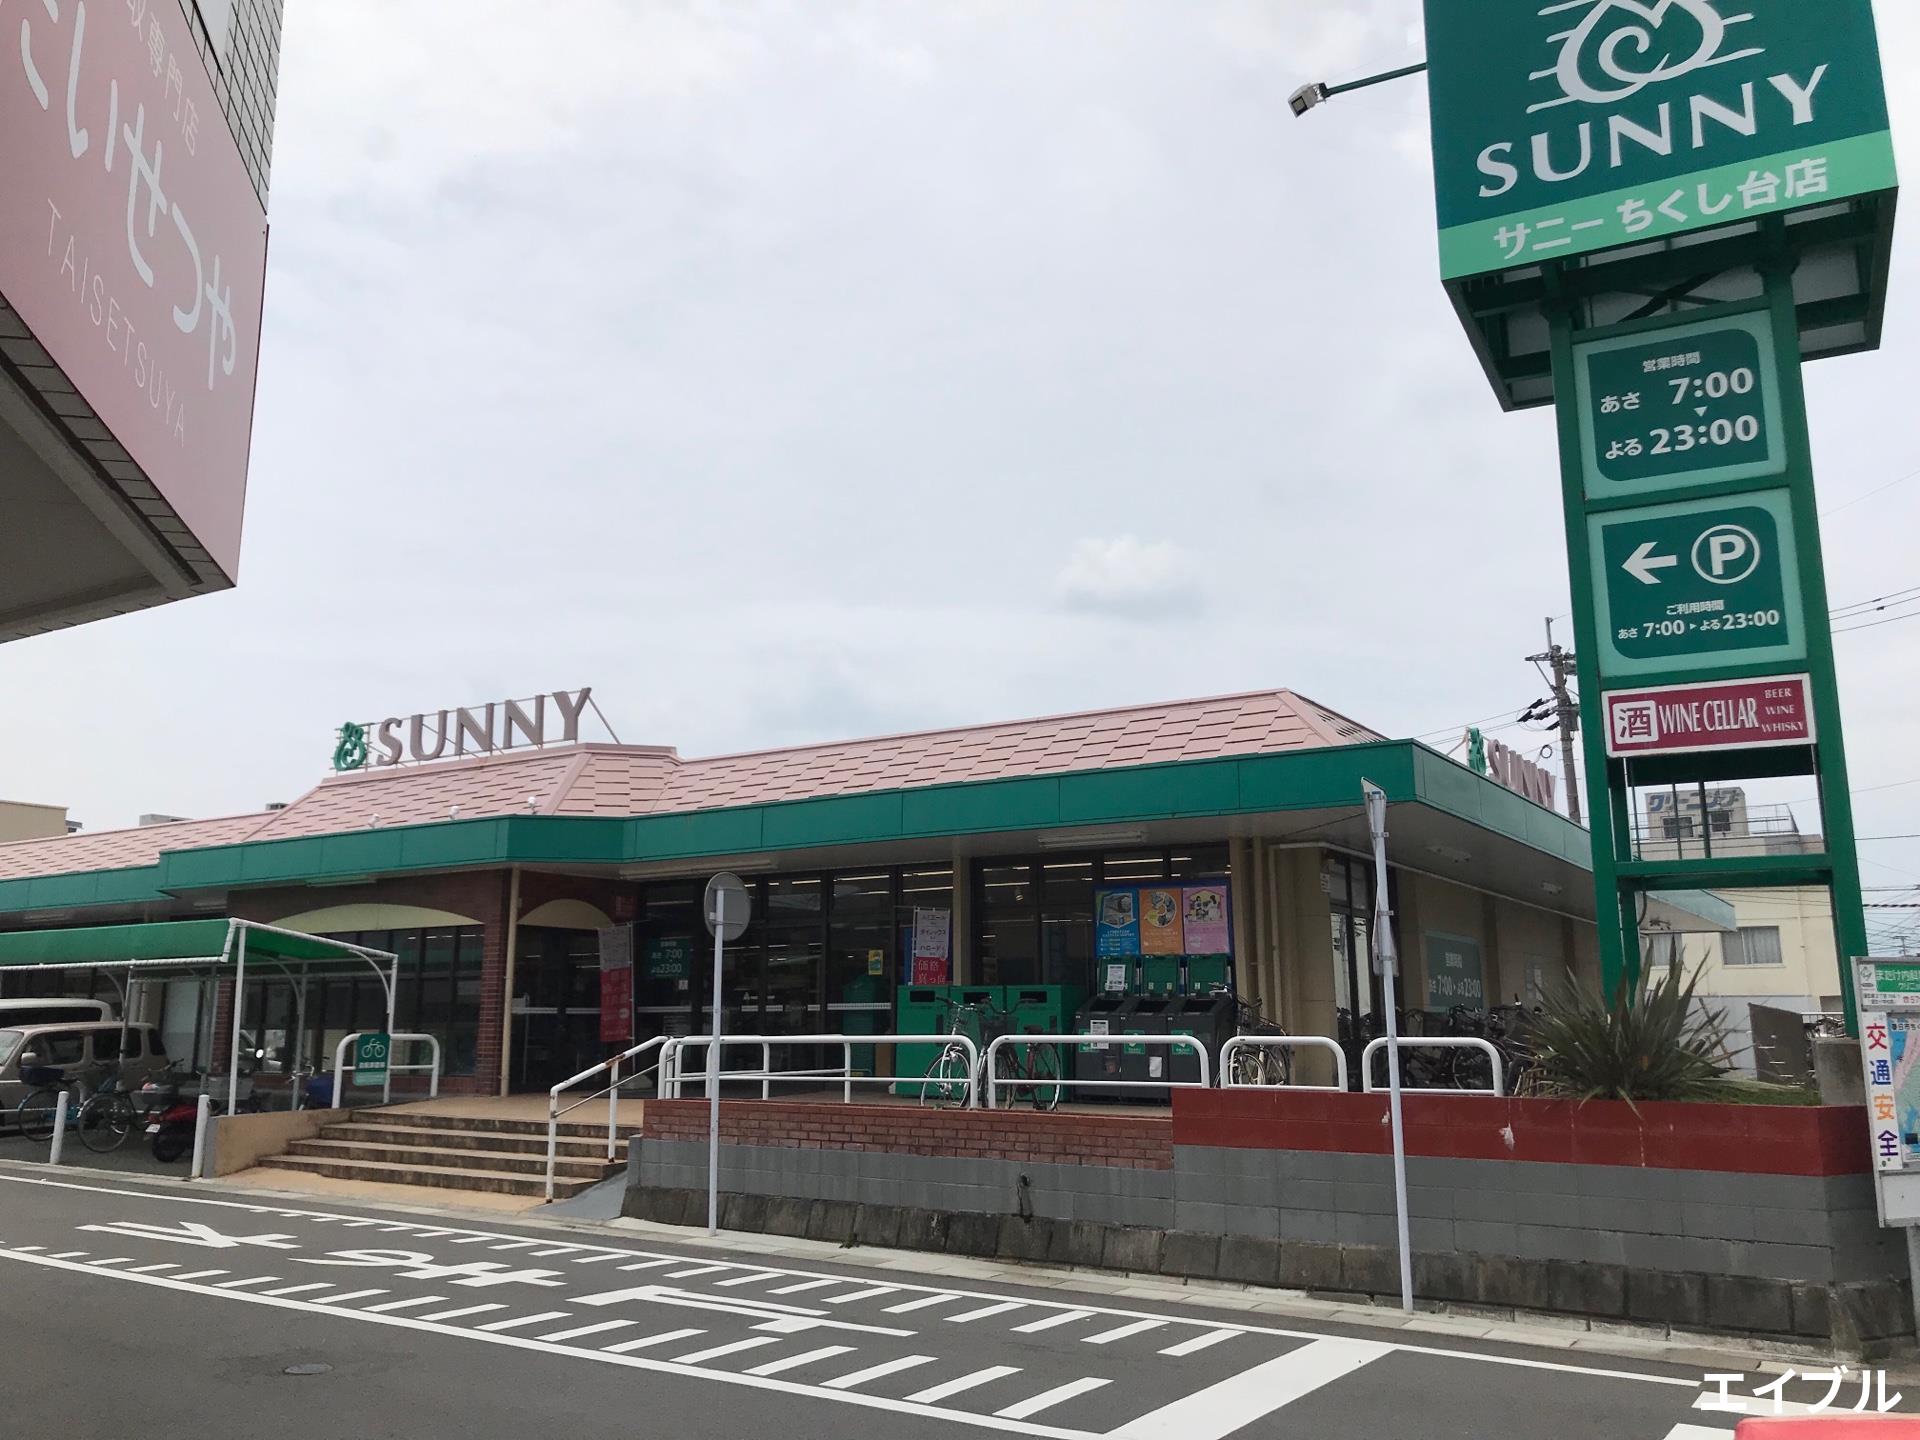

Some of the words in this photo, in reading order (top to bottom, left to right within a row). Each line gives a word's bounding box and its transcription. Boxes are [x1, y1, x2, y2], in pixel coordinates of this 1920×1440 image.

[1476, 64, 1829, 198] SUNNY
[47, 197, 185, 448] TAISETSUYA
[1642, 351, 1701, 373] 営業時間
[1600, 391, 1641, 414] あさ
[1668, 367, 1755, 405] 7:00
[1605, 437, 1643, 460] よる
[1649, 414, 1759, 455] 23:00
[1708, 534, 1746, 576] P
[1618, 627, 1638, 640] あさ
[1643, 619, 1685, 638] 7:00
[1700, 618, 1721, 631] よる
[1722, 609, 1779, 631] 23:00
[1666, 599, 1724, 615] ご利用時間
[1764, 687, 1792, 699] BEER
[1765, 704, 1795, 716] WINE
[376, 687, 592, 766] SUNNY
[1618, 706, 1652, 738] 酒
[1658, 702, 1702, 735] WINE
[1703, 697, 1760, 731] CELLAR
[1761, 720, 1804, 733] WHISKY
[1865, 1022, 1899, 1158] 交通安全
